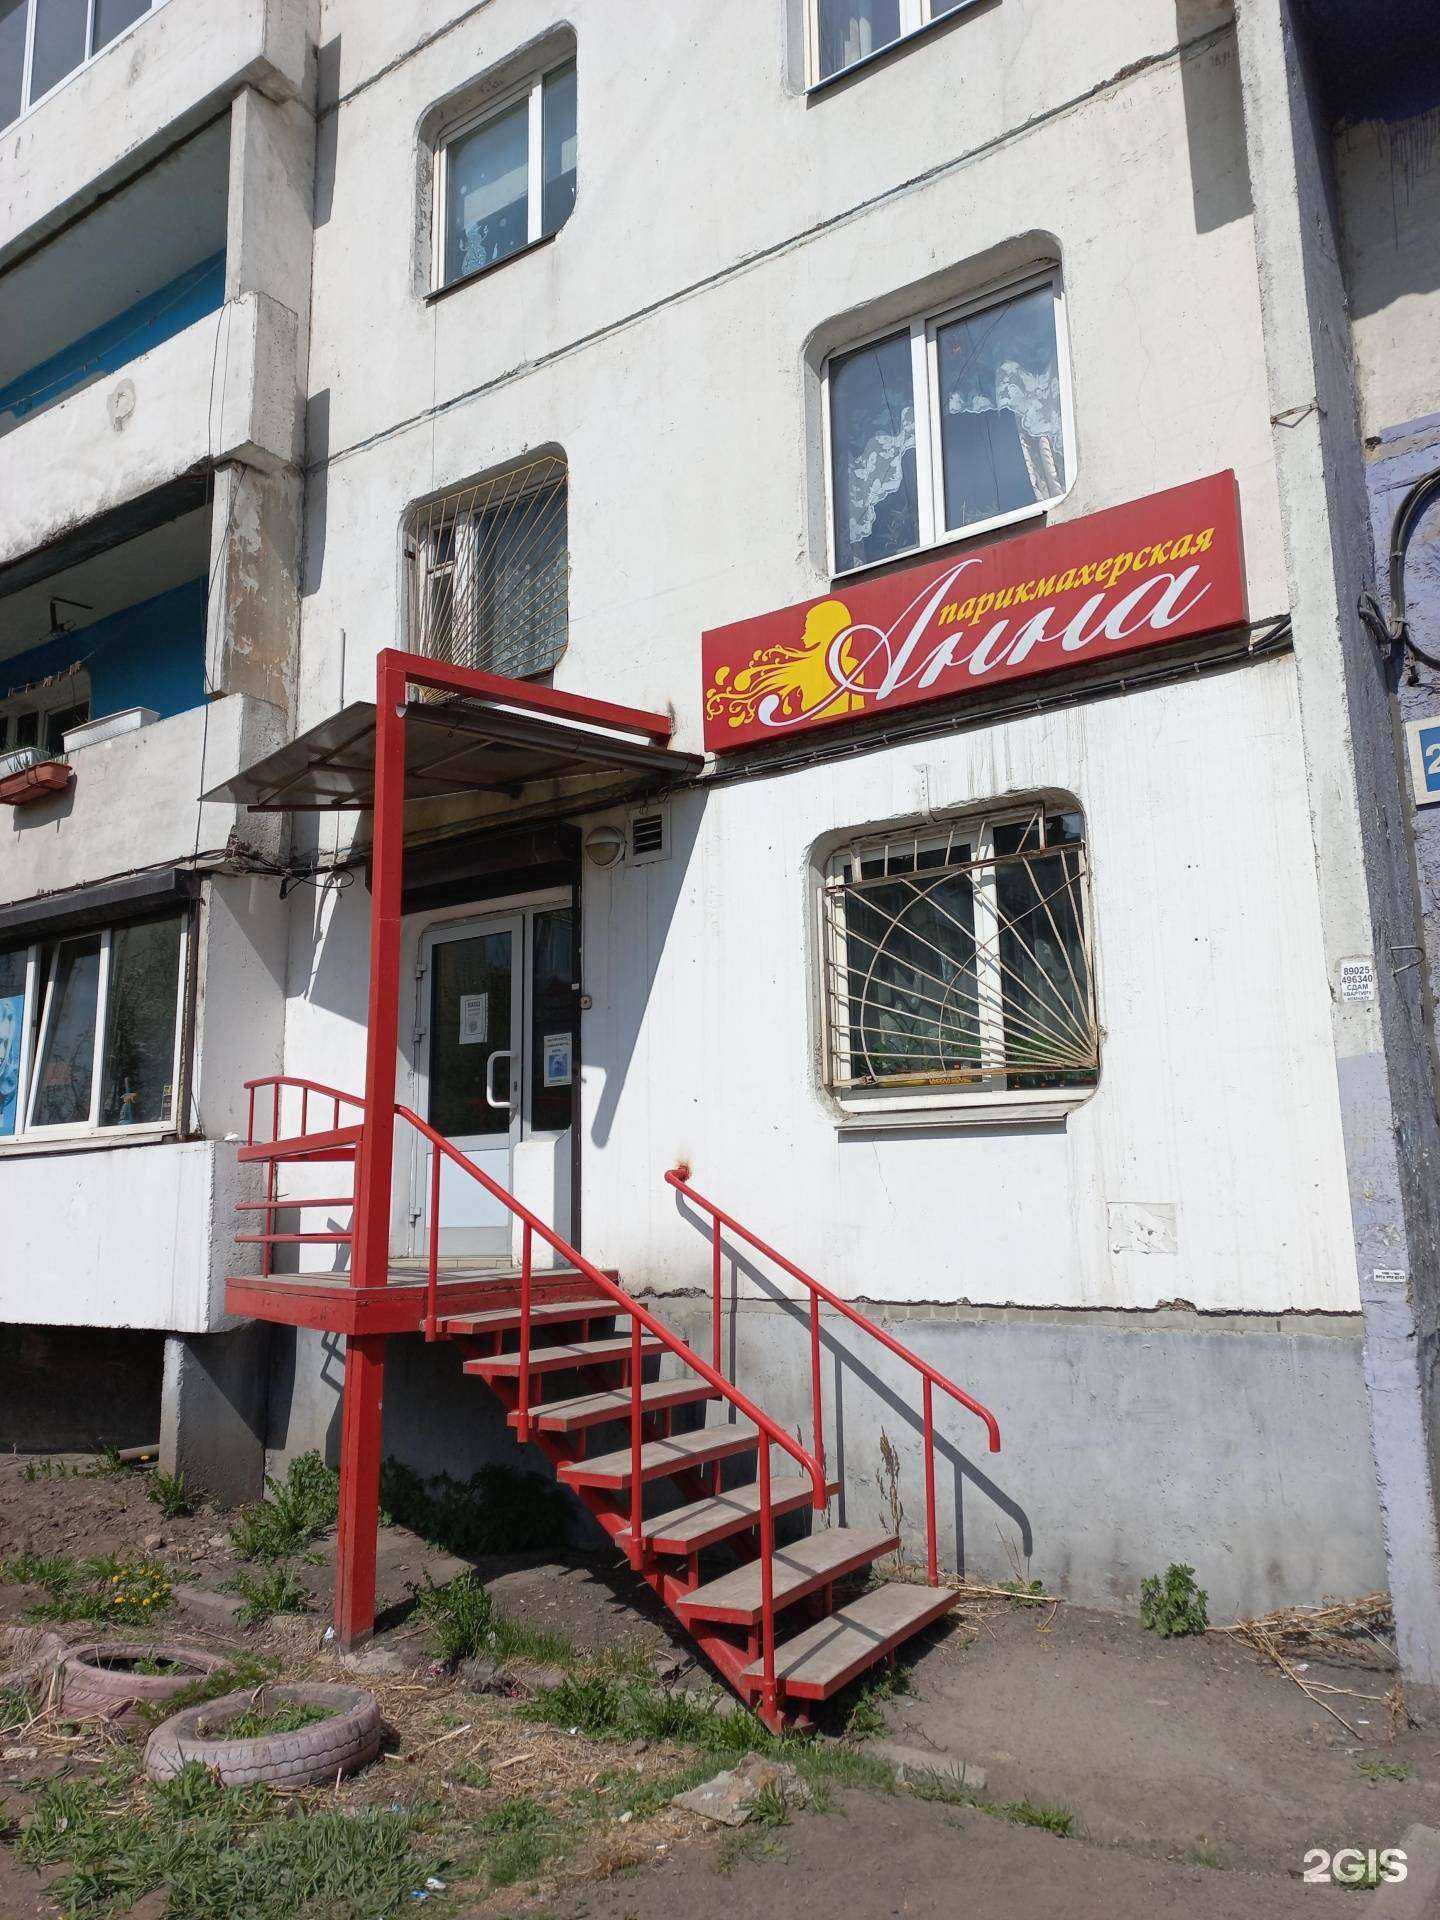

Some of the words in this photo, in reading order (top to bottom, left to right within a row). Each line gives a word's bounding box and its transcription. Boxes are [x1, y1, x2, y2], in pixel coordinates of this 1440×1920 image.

[938, 528, 1214, 626] парикмахерская
[758, 558, 1213, 728] Анна
[1343, 966, 1370, 976] 89025
[1341, 974, 1373, 984] 496340
[1346, 983, 1369, 991] СДАМ
